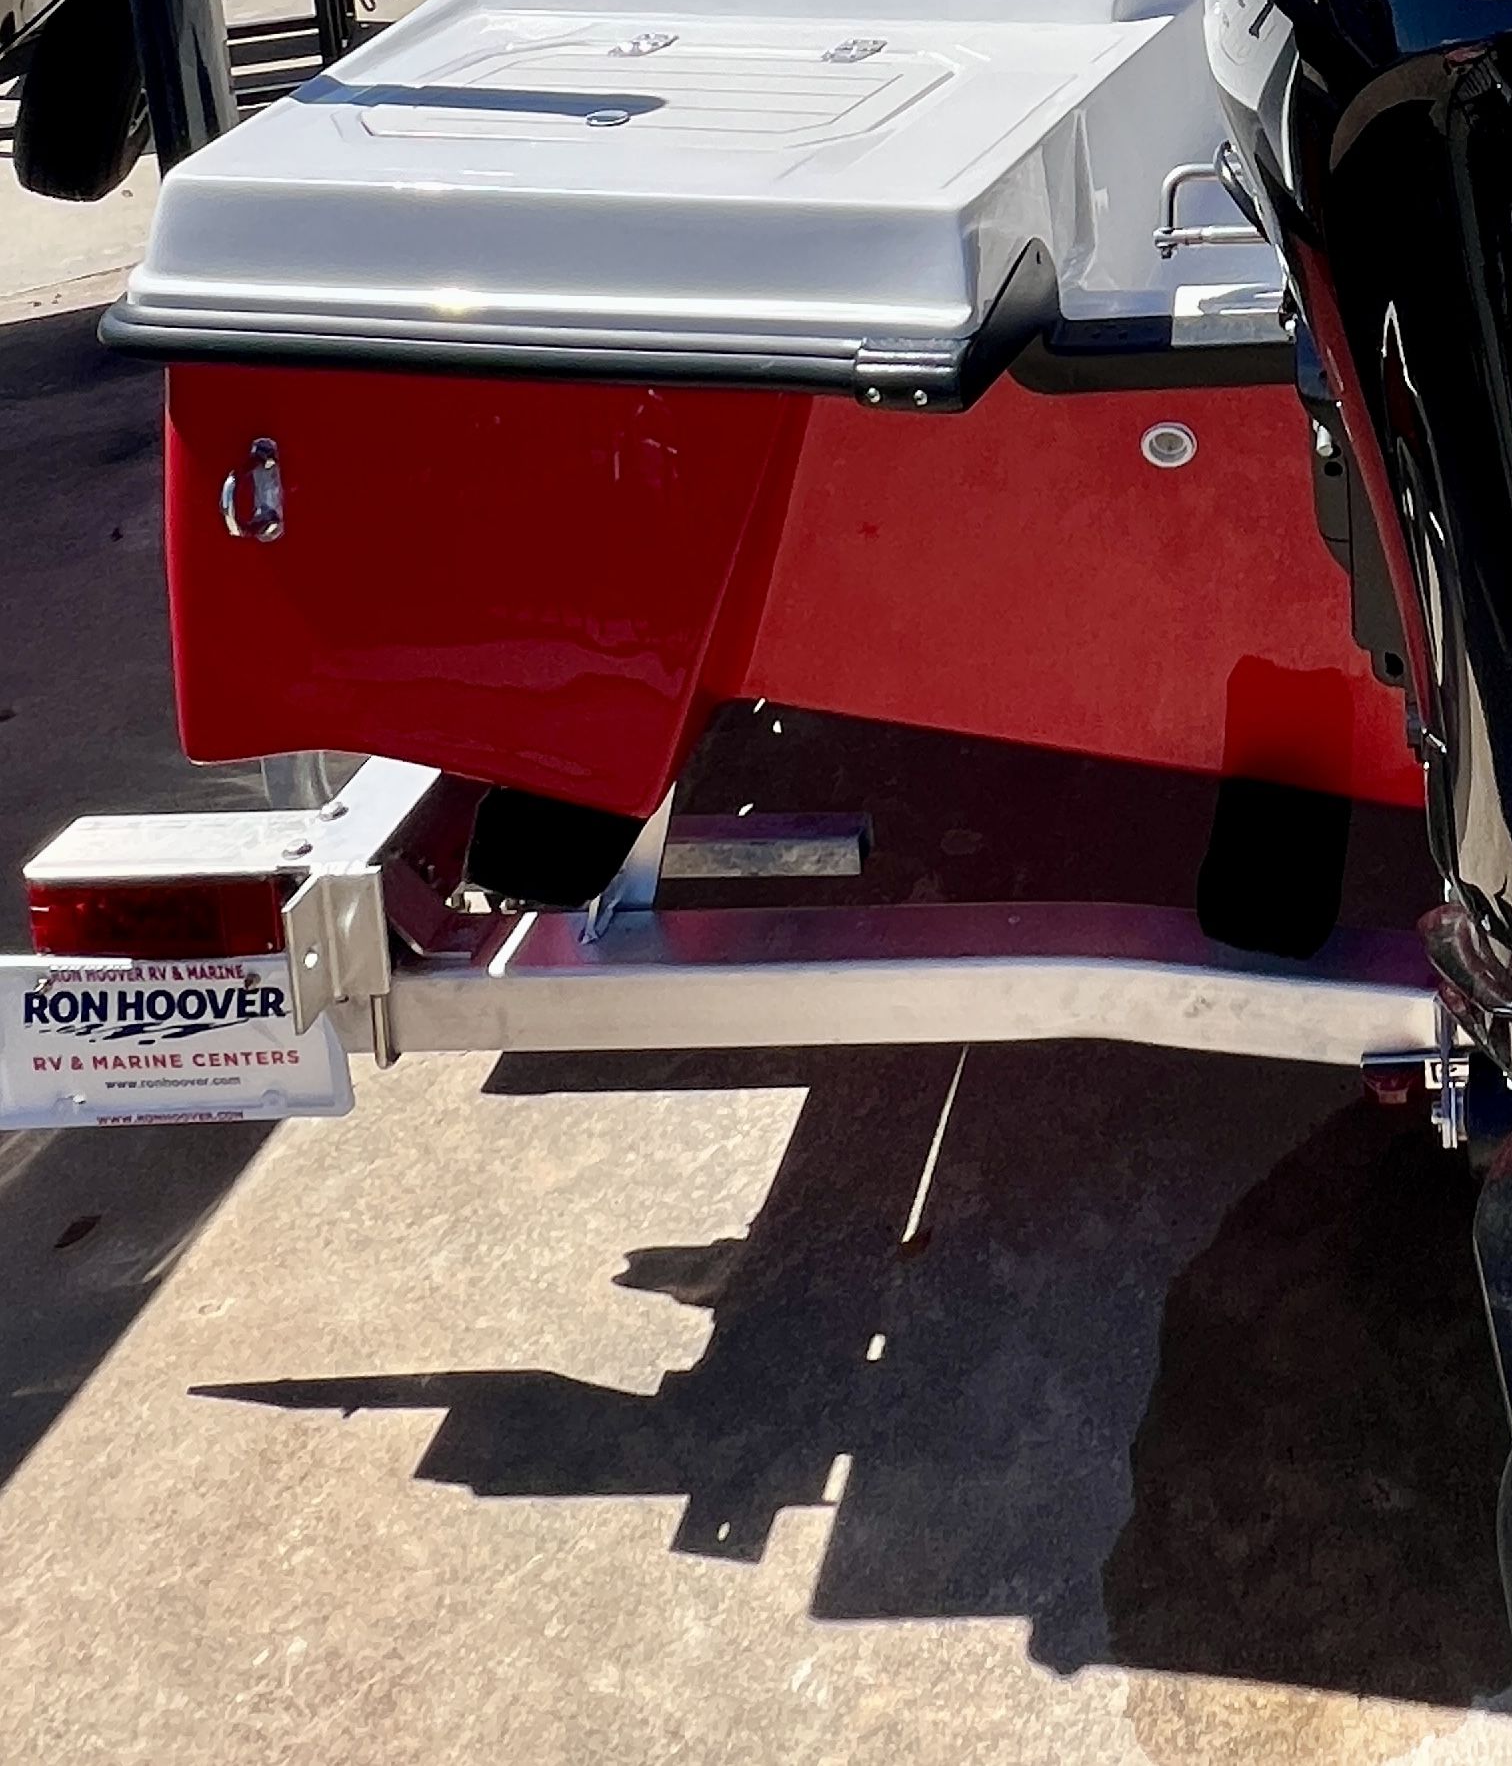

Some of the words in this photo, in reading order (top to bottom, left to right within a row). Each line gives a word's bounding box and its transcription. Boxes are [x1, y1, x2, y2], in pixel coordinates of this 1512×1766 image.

[85, 966, 146, 983] HOOVER
[148, 965, 168, 982] RV
[172, 965, 184, 981] &
[187, 964, 244, 981] MARINE
[24, 990, 108, 1025] RON
[117, 987, 286, 1022] HOOVER
[32, 1056, 62, 1071] RV
[70, 1055, 85, 1070] &
[93, 1053, 184, 1070] MARINE
[192, 1050, 300, 1067] CENTERS
[104, 1076, 241, 1089] www.ronhoover.com
